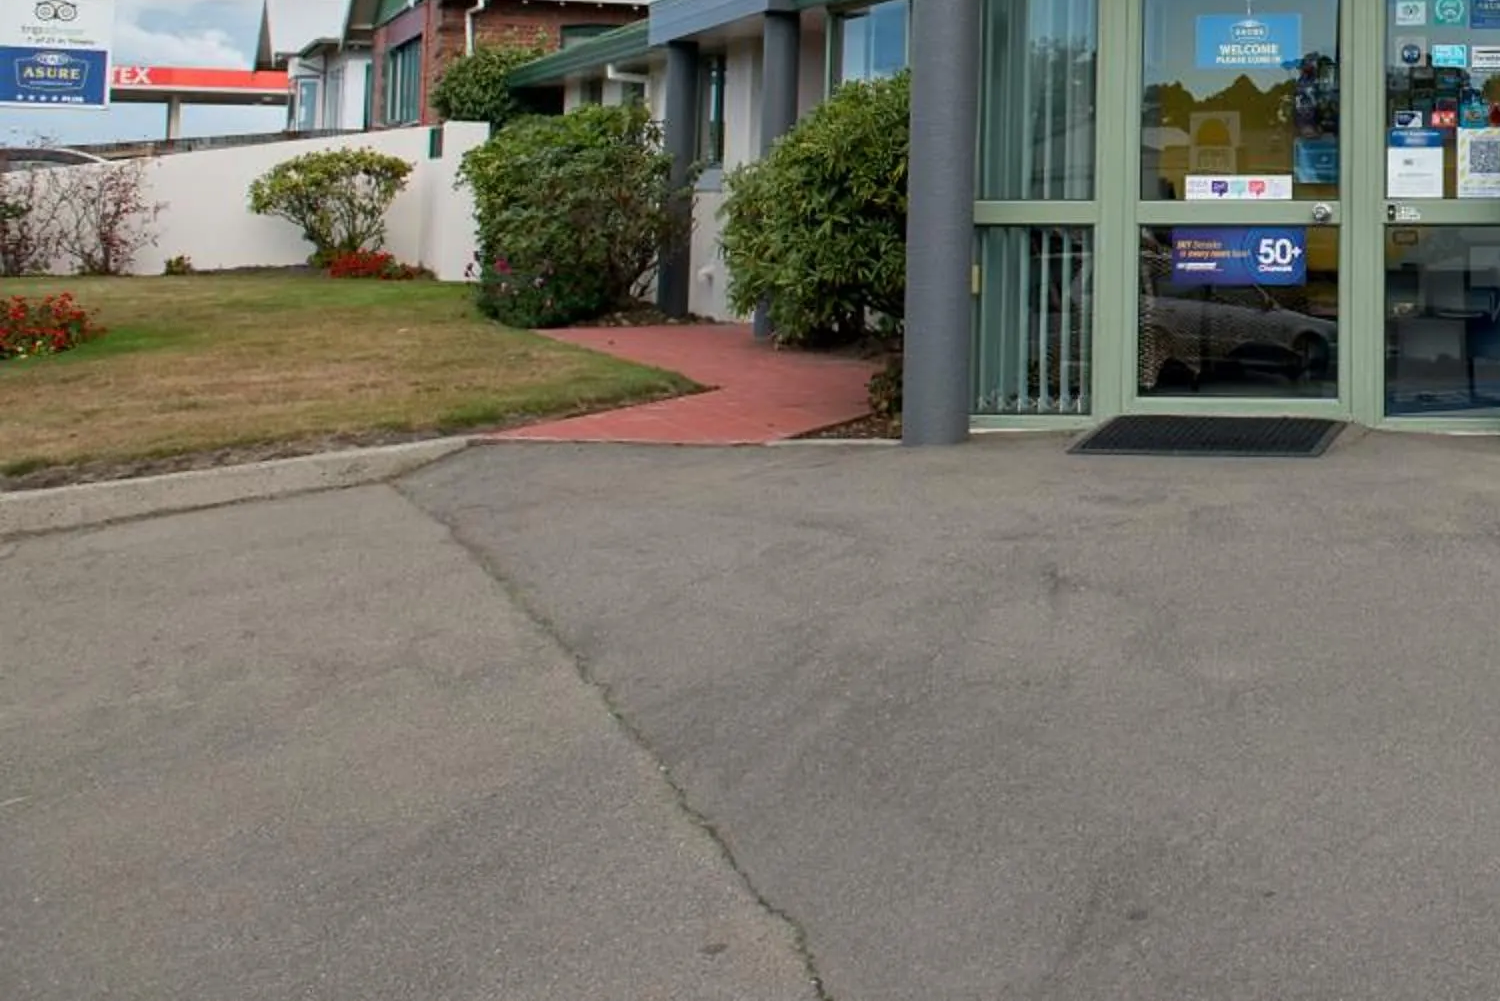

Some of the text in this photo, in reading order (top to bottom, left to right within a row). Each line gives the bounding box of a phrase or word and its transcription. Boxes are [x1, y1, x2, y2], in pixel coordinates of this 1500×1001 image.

[1218, 43, 1279, 55] WELCOME
[23, 66, 81, 80] ASURE
[1257, 238, 1303, 265] 50+
